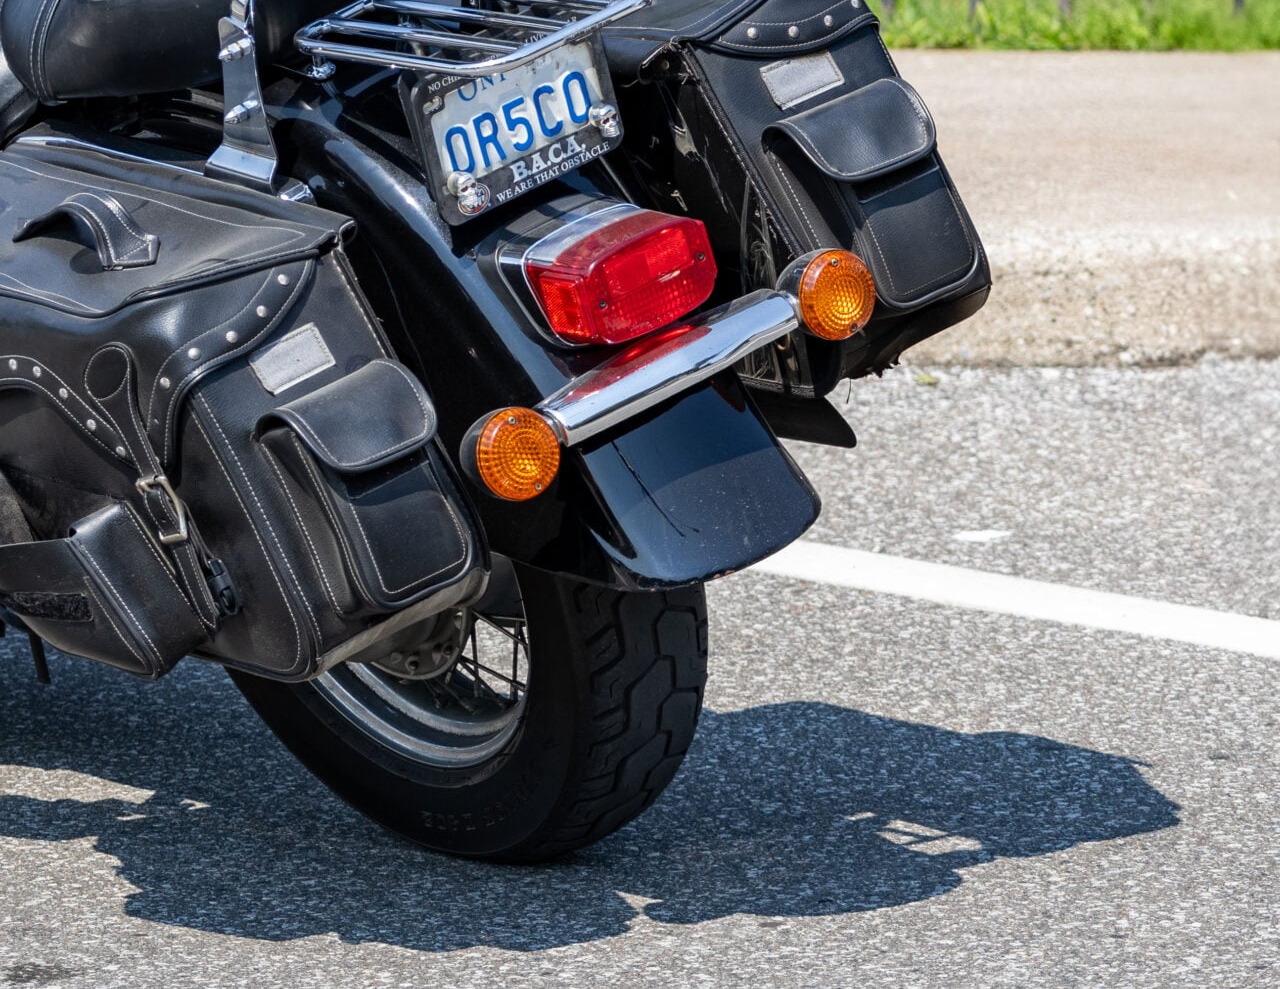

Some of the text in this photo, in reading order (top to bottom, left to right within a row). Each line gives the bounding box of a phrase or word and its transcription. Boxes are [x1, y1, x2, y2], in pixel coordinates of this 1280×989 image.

[428, 81, 441, 93] NO
[496, 141, 611, 203] WE ARE THAT OBSTACLE
[509, 135, 586, 183] B.A.C.A.
